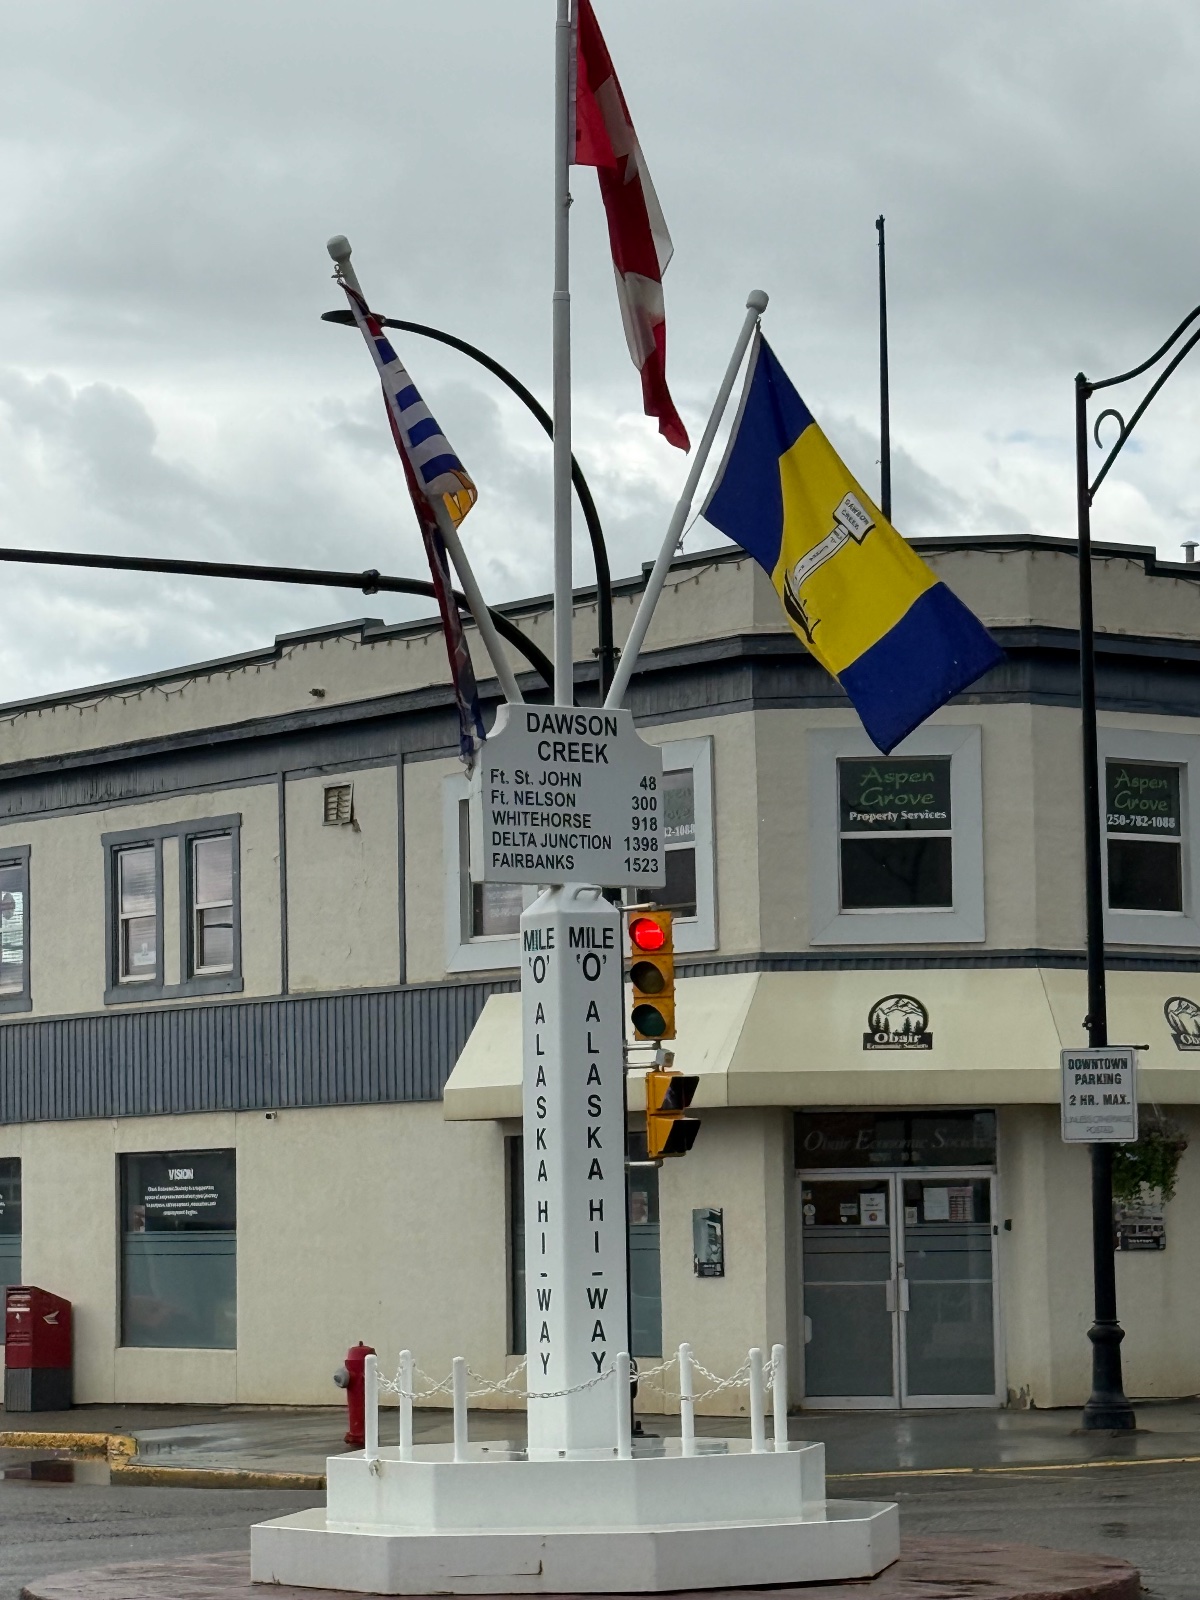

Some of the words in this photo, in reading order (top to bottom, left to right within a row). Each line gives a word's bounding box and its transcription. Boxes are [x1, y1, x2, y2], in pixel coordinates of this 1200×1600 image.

[526, 712, 618, 737] DAWSON
[537, 740, 609, 764] CREEK
[490, 768, 510, 785] Ft.
[514, 769, 534, 786] St.
[538, 771, 582, 788] JOHN
[639, 775, 657, 791] 48
[860, 766, 935, 789] Aspen
[1113, 768, 1168, 794] Aspen
[491, 789, 509, 805] Ft.
[514, 790, 576, 808] NELSON
[631, 796, 658, 811] 300
[860, 786, 936, 806] Grove
[1114, 790, 1169, 811] Grove
[492, 810, 592, 829] WHITEHORSE
[631, 816, 658, 832] 918
[849, 811, 899, 823] Property
[900, 809, 947, 820] Services
[1106, 814, 1176, 828] 250-782-1088
[492, 831, 538, 848] DELTA
[540, 833, 612, 850] JUNCTION
[623, 836, 659, 852] 1398
[492, 852, 575, 870] FAIRBANKS
[624, 858, 659, 873] 1523
[523, 927, 555, 952] MILE
[569, 926, 615, 949] MILE
[1067, 1058, 1128, 1070] DOWNTOWN
[1074, 1073, 1122, 1085] PARKING
[535, 1001, 548, 1182] ALASKA
[585, 1000, 604, 1180] ALASKA
[1069, 1094, 1077, 1106] 2
[1080, 1094, 1099, 1106] HR.
[1102, 1093, 1131, 1106] MAX.
[168, 1168, 194, 1180] VISION
